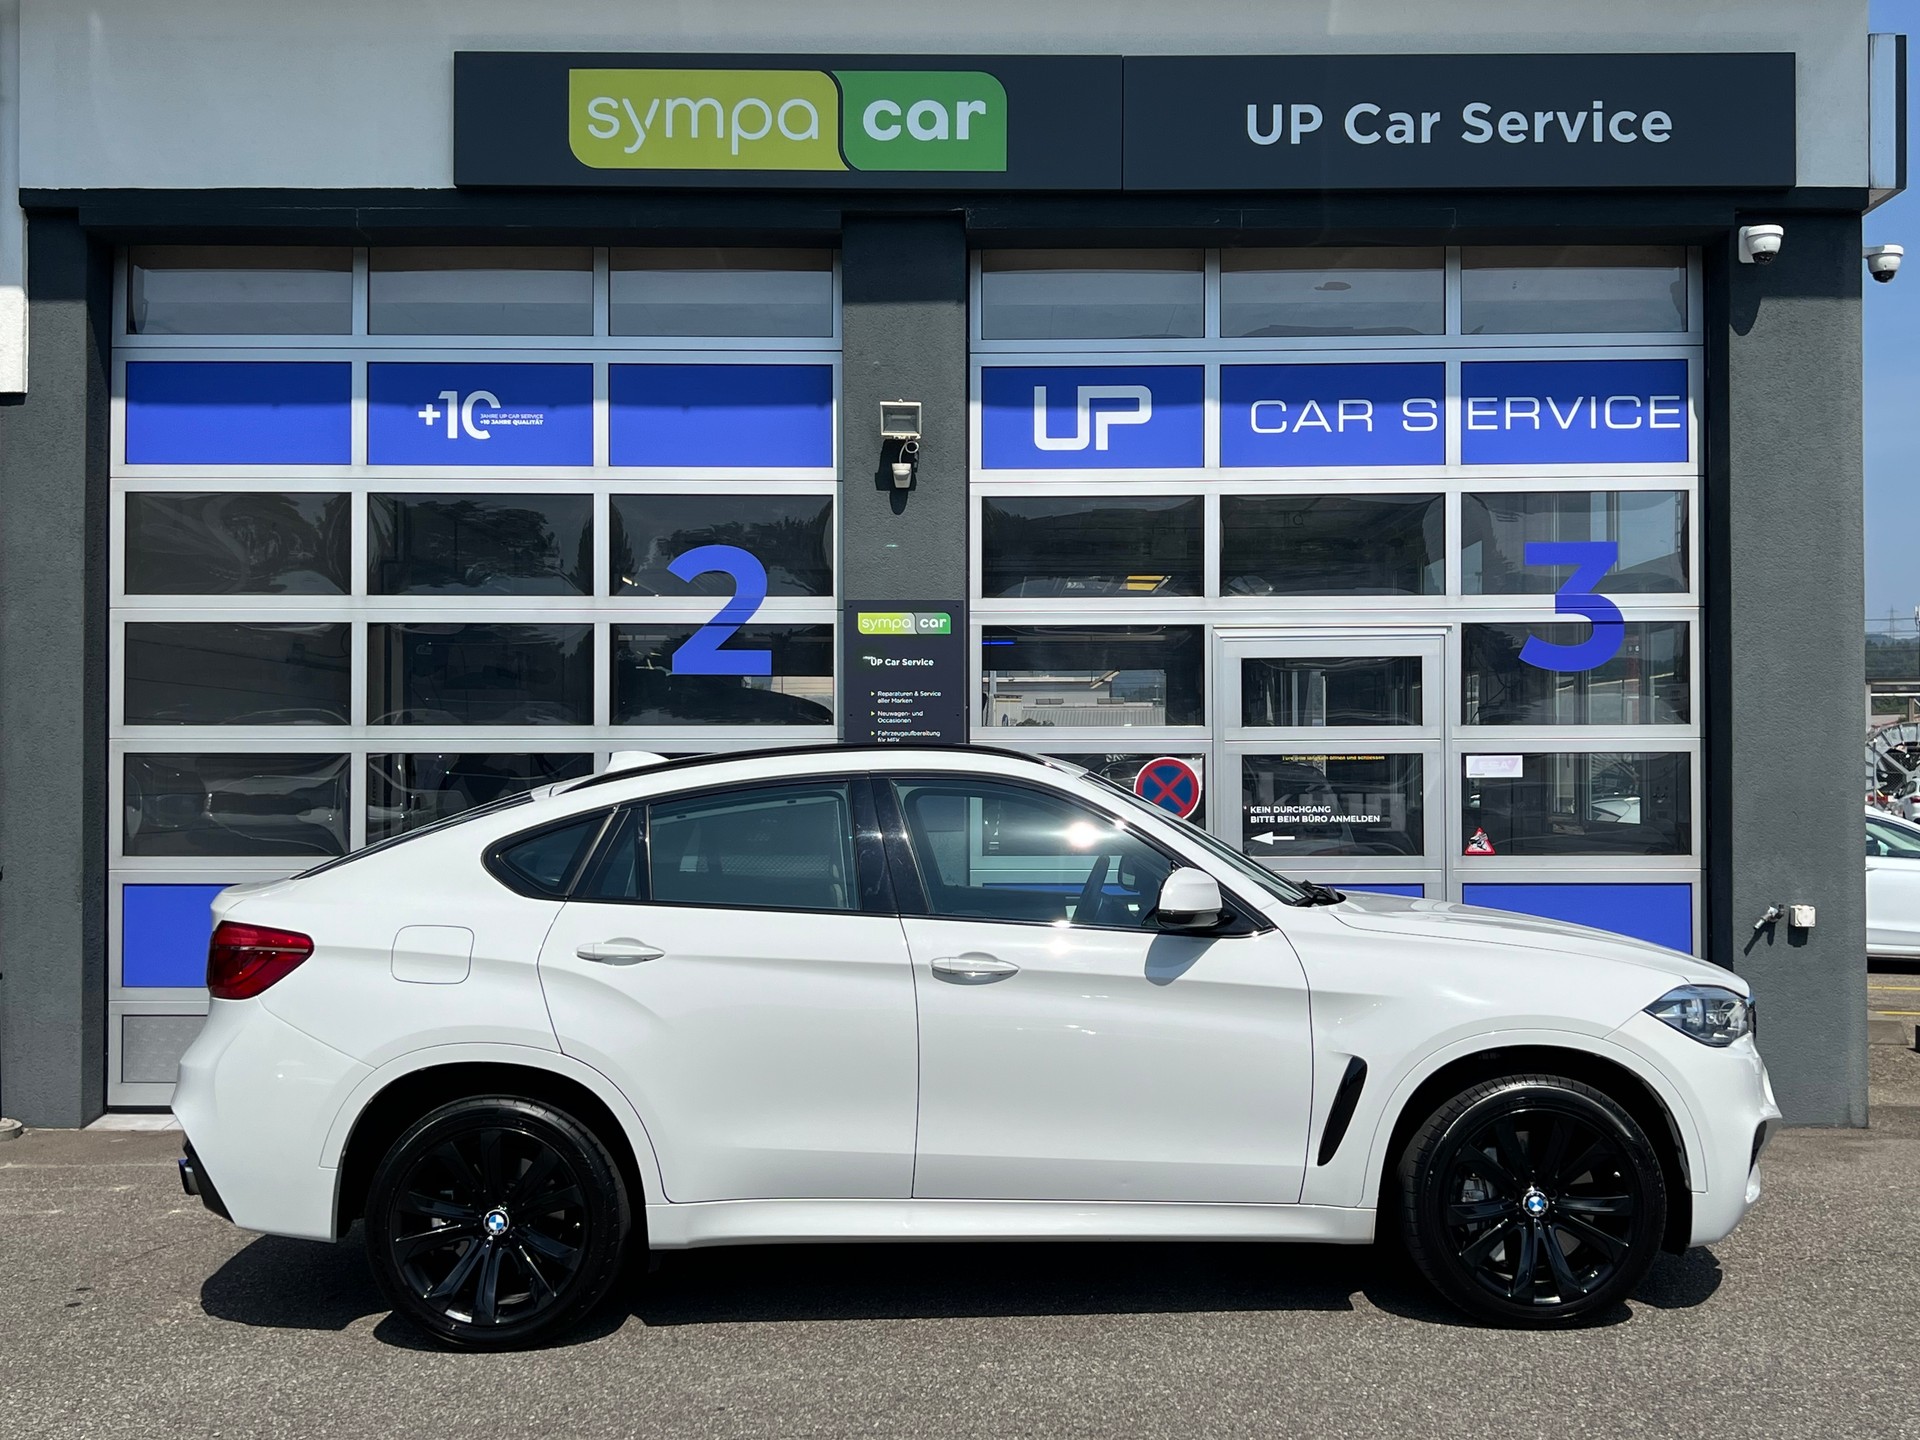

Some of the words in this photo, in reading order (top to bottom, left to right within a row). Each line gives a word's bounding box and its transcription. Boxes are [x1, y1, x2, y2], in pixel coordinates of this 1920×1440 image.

[587, 96, 819, 156] sympa
[862, 99, 987, 142] car
[1246, 104, 1323, 146] UP
[1344, 102, 1441, 145] Car
[1461, 100, 1674, 144] Service
[1033, 385, 1153, 452] UP
[1250, 399, 1374, 434] CAR
[667, 544, 773, 676] 2
[861, 618, 912, 631] sympa
[919, 618, 947, 628] car
[1518, 541, 1625, 673] 3
[884, 658, 900, 667] Car
[901, 658, 935, 667] Service
[1250, 805, 1271, 814] KEIN
[1273, 805, 1331, 814] DURCHGANG
[1250, 815, 1276, 824] BITTE
[1277, 815, 1300, 823] BEIM
[1301, 813, 1328, 823] BÜRO
[1329, 814, 1381, 823] ANMELDEN
